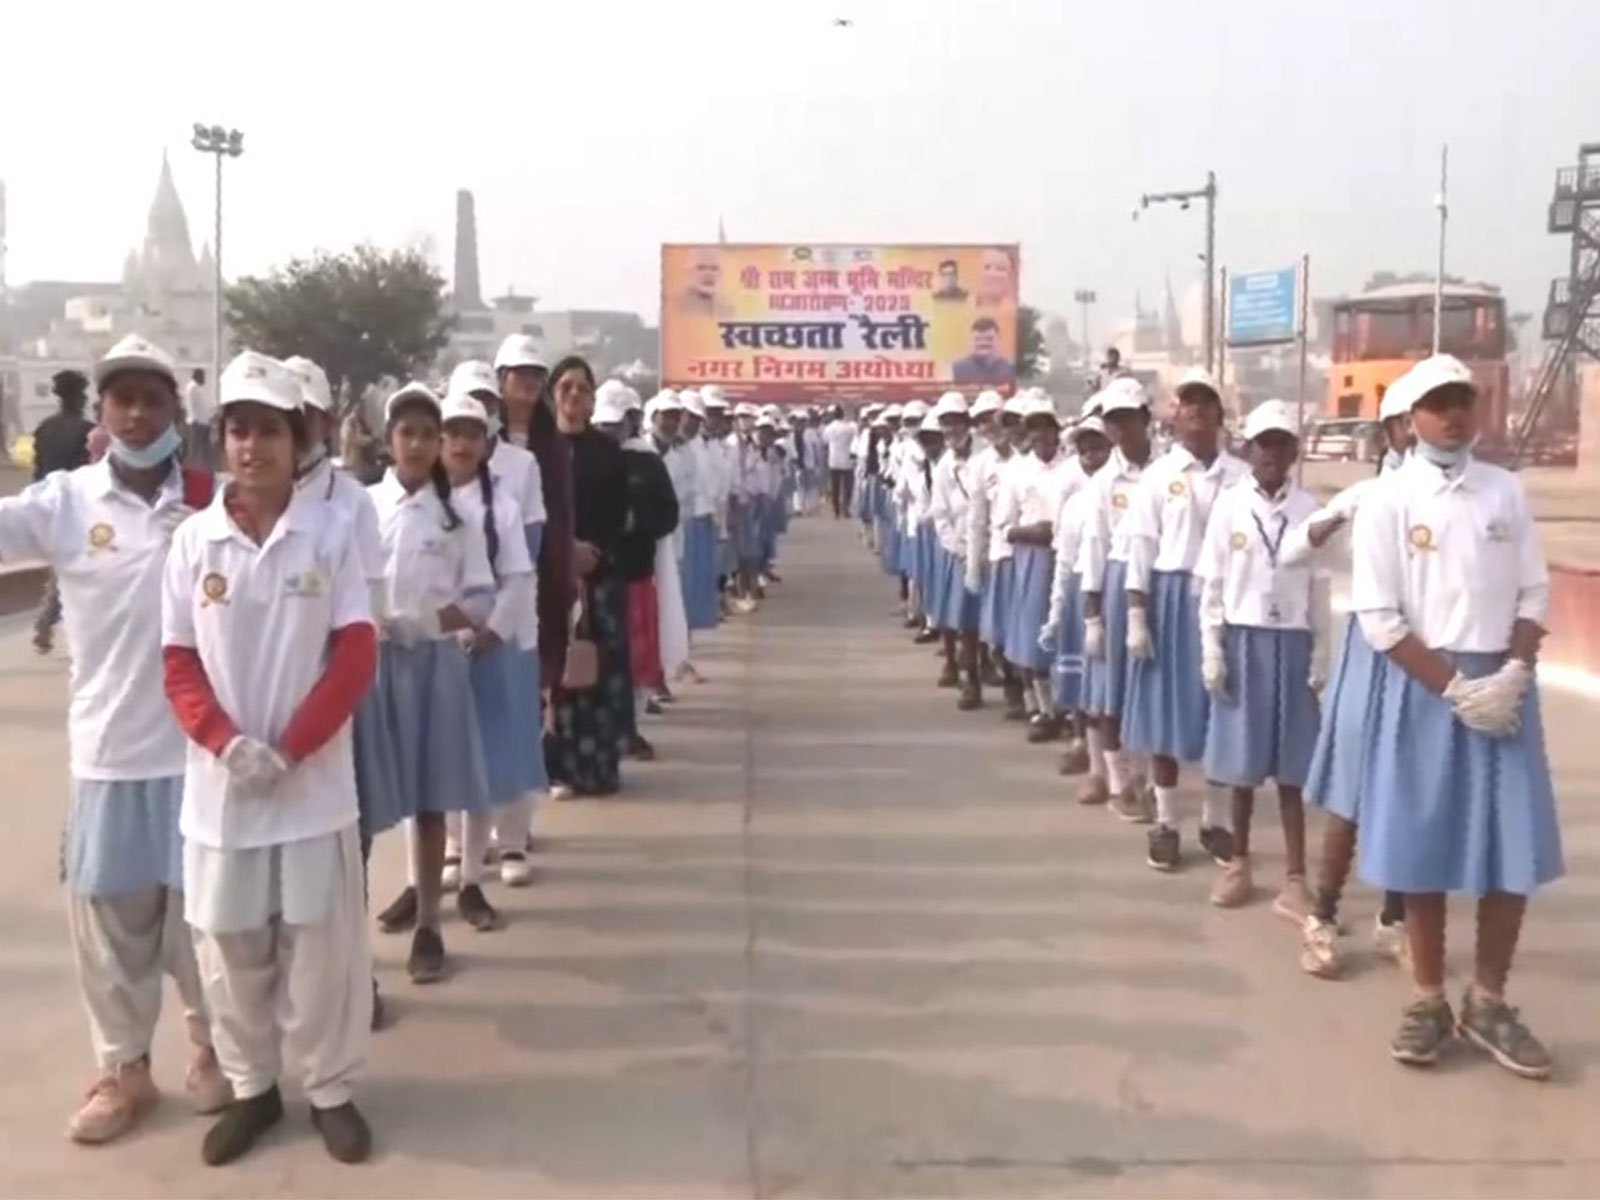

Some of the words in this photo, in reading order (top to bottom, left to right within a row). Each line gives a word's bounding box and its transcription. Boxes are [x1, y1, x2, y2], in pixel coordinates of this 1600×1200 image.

[769, 270, 796, 289] राम
[802, 270, 839, 290] जन्म
[847, 266, 879, 295] भूमि
[718, 321, 846, 349] स्वच्छता
[849, 315, 928, 350] रैली
[687, 359, 743, 378] नगर
[753, 356, 826, 378] निगम
[836, 355, 935, 379] अयोध्या
